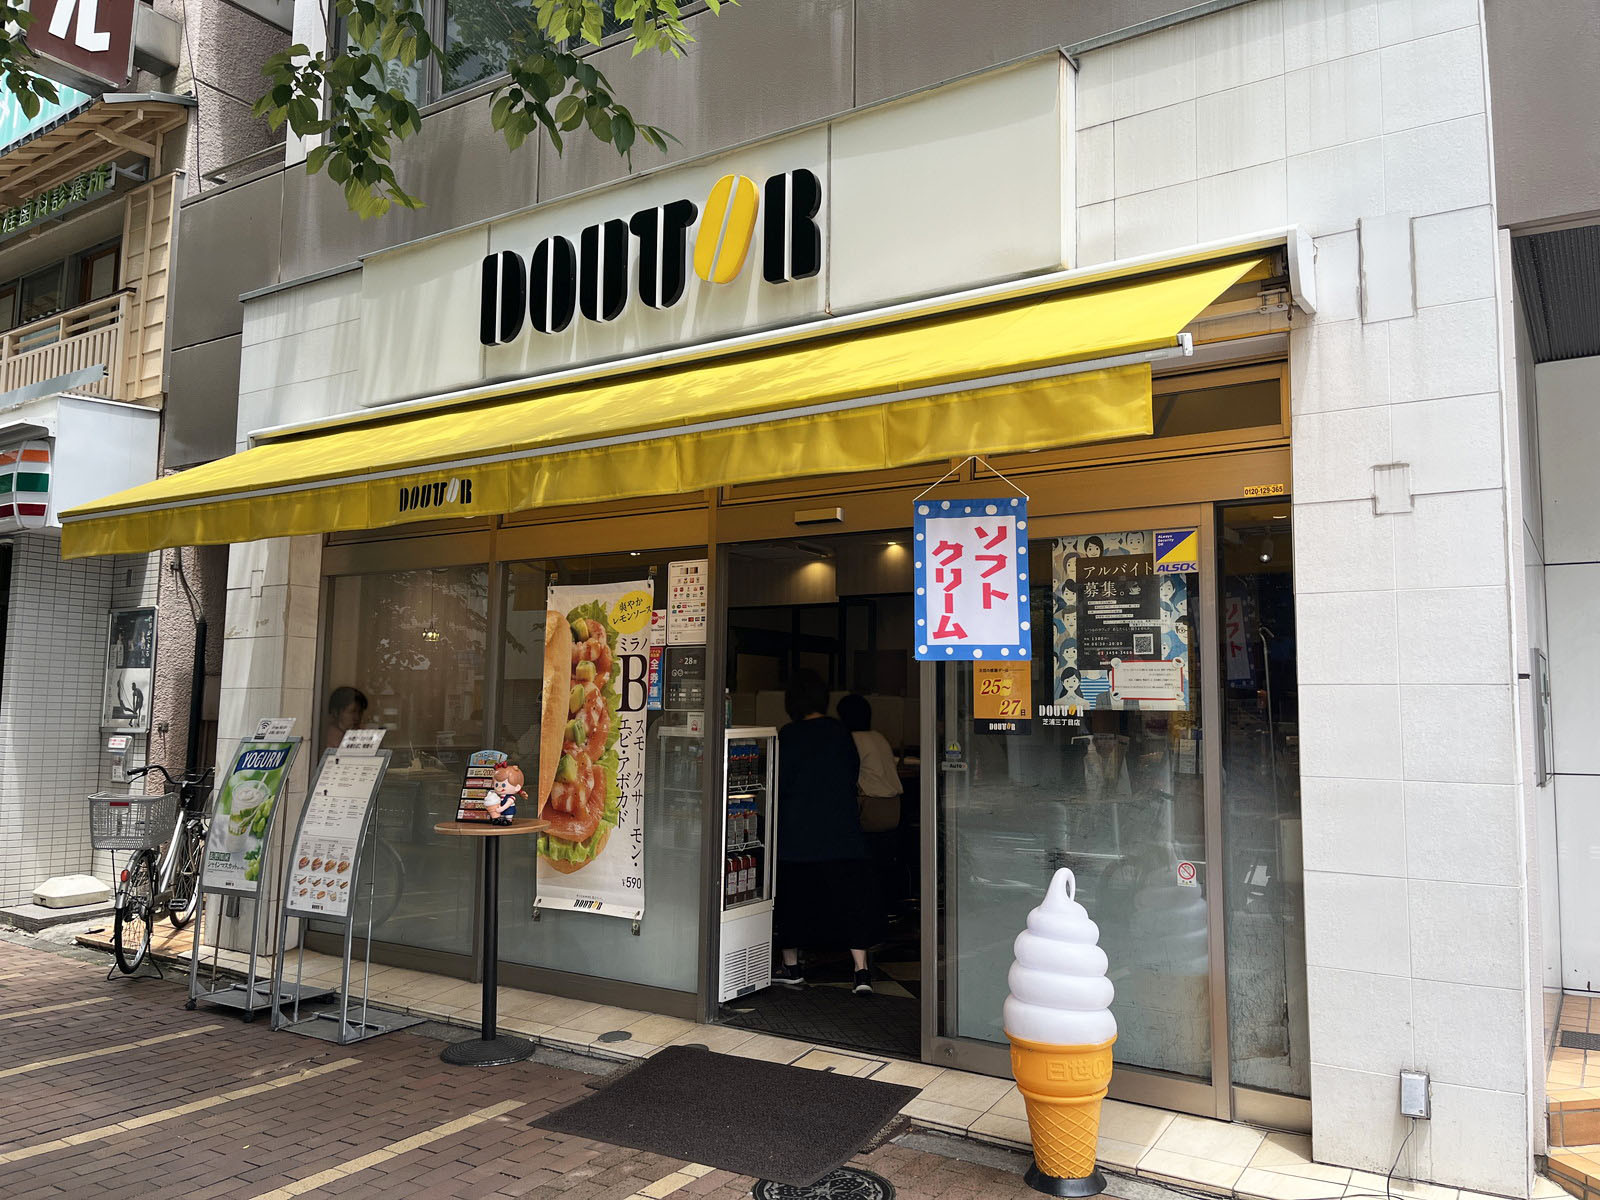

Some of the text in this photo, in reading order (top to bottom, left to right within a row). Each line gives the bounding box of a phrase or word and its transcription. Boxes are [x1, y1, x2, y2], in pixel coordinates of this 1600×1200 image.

[480, 168, 822, 346] DOUTOR
[400, 478, 472, 512] DOUTOR
[1244, 486, 1283, 495] 0120-129-365
[974, 526, 1009, 609] ソフト
[1084, 562, 1152, 579] アルバイト
[1157, 562, 1196, 572] ALSOK
[932, 541, 968, 639] クリーム
[619, 597, 643, 613] 爽やか
[613, 605, 652, 624] レモンソース
[621, 637, 648, 651] ミラノ
[615, 654, 648, 712] B
[1039, 704, 1084, 717] DOUTOR
[989, 722, 1015, 731] DOUTOR
[242, 751, 285, 768] YOGURN
[616, 719, 632, 828] エビ・アボカド
[622, 877, 641, 889] ¥590
